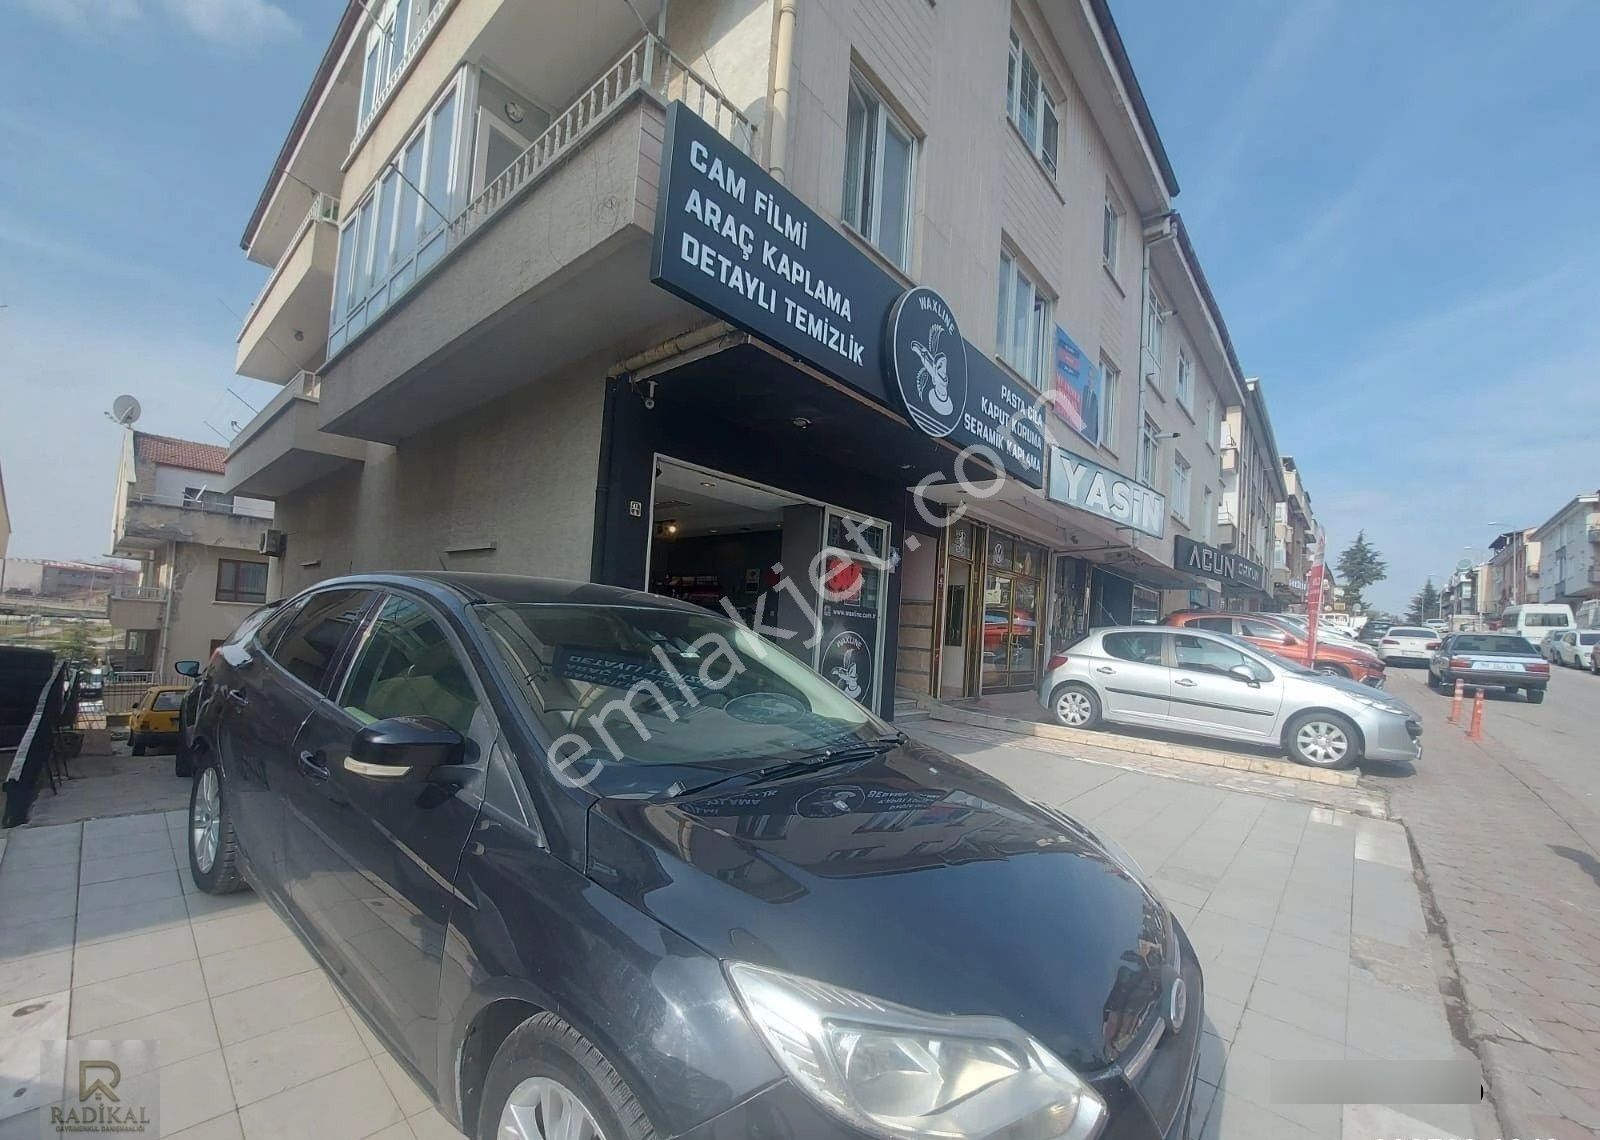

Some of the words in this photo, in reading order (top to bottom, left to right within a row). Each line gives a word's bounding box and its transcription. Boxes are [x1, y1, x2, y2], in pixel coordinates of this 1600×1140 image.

[690, 140, 746, 204] CAM
[754, 190, 808, 250] FİLMİ
[685, 189, 754, 261] ARAÇ
[763, 240, 851, 322] KAPLAMA
[681, 232, 777, 313] DETAYLI
[785, 297, 865, 367] TEMİZLİK
[919, 296, 954, 336] WAXLINE
[982, 396, 1009, 428] KAPUT
[1011, 417, 1042, 451] KORUMA
[1001, 385, 1026, 416] PASTA
[964, 413, 1004, 449] SERAMİK
[1007, 440, 1041, 473] KAPLAMA
[1060, 455, 1160, 531] YASİN
